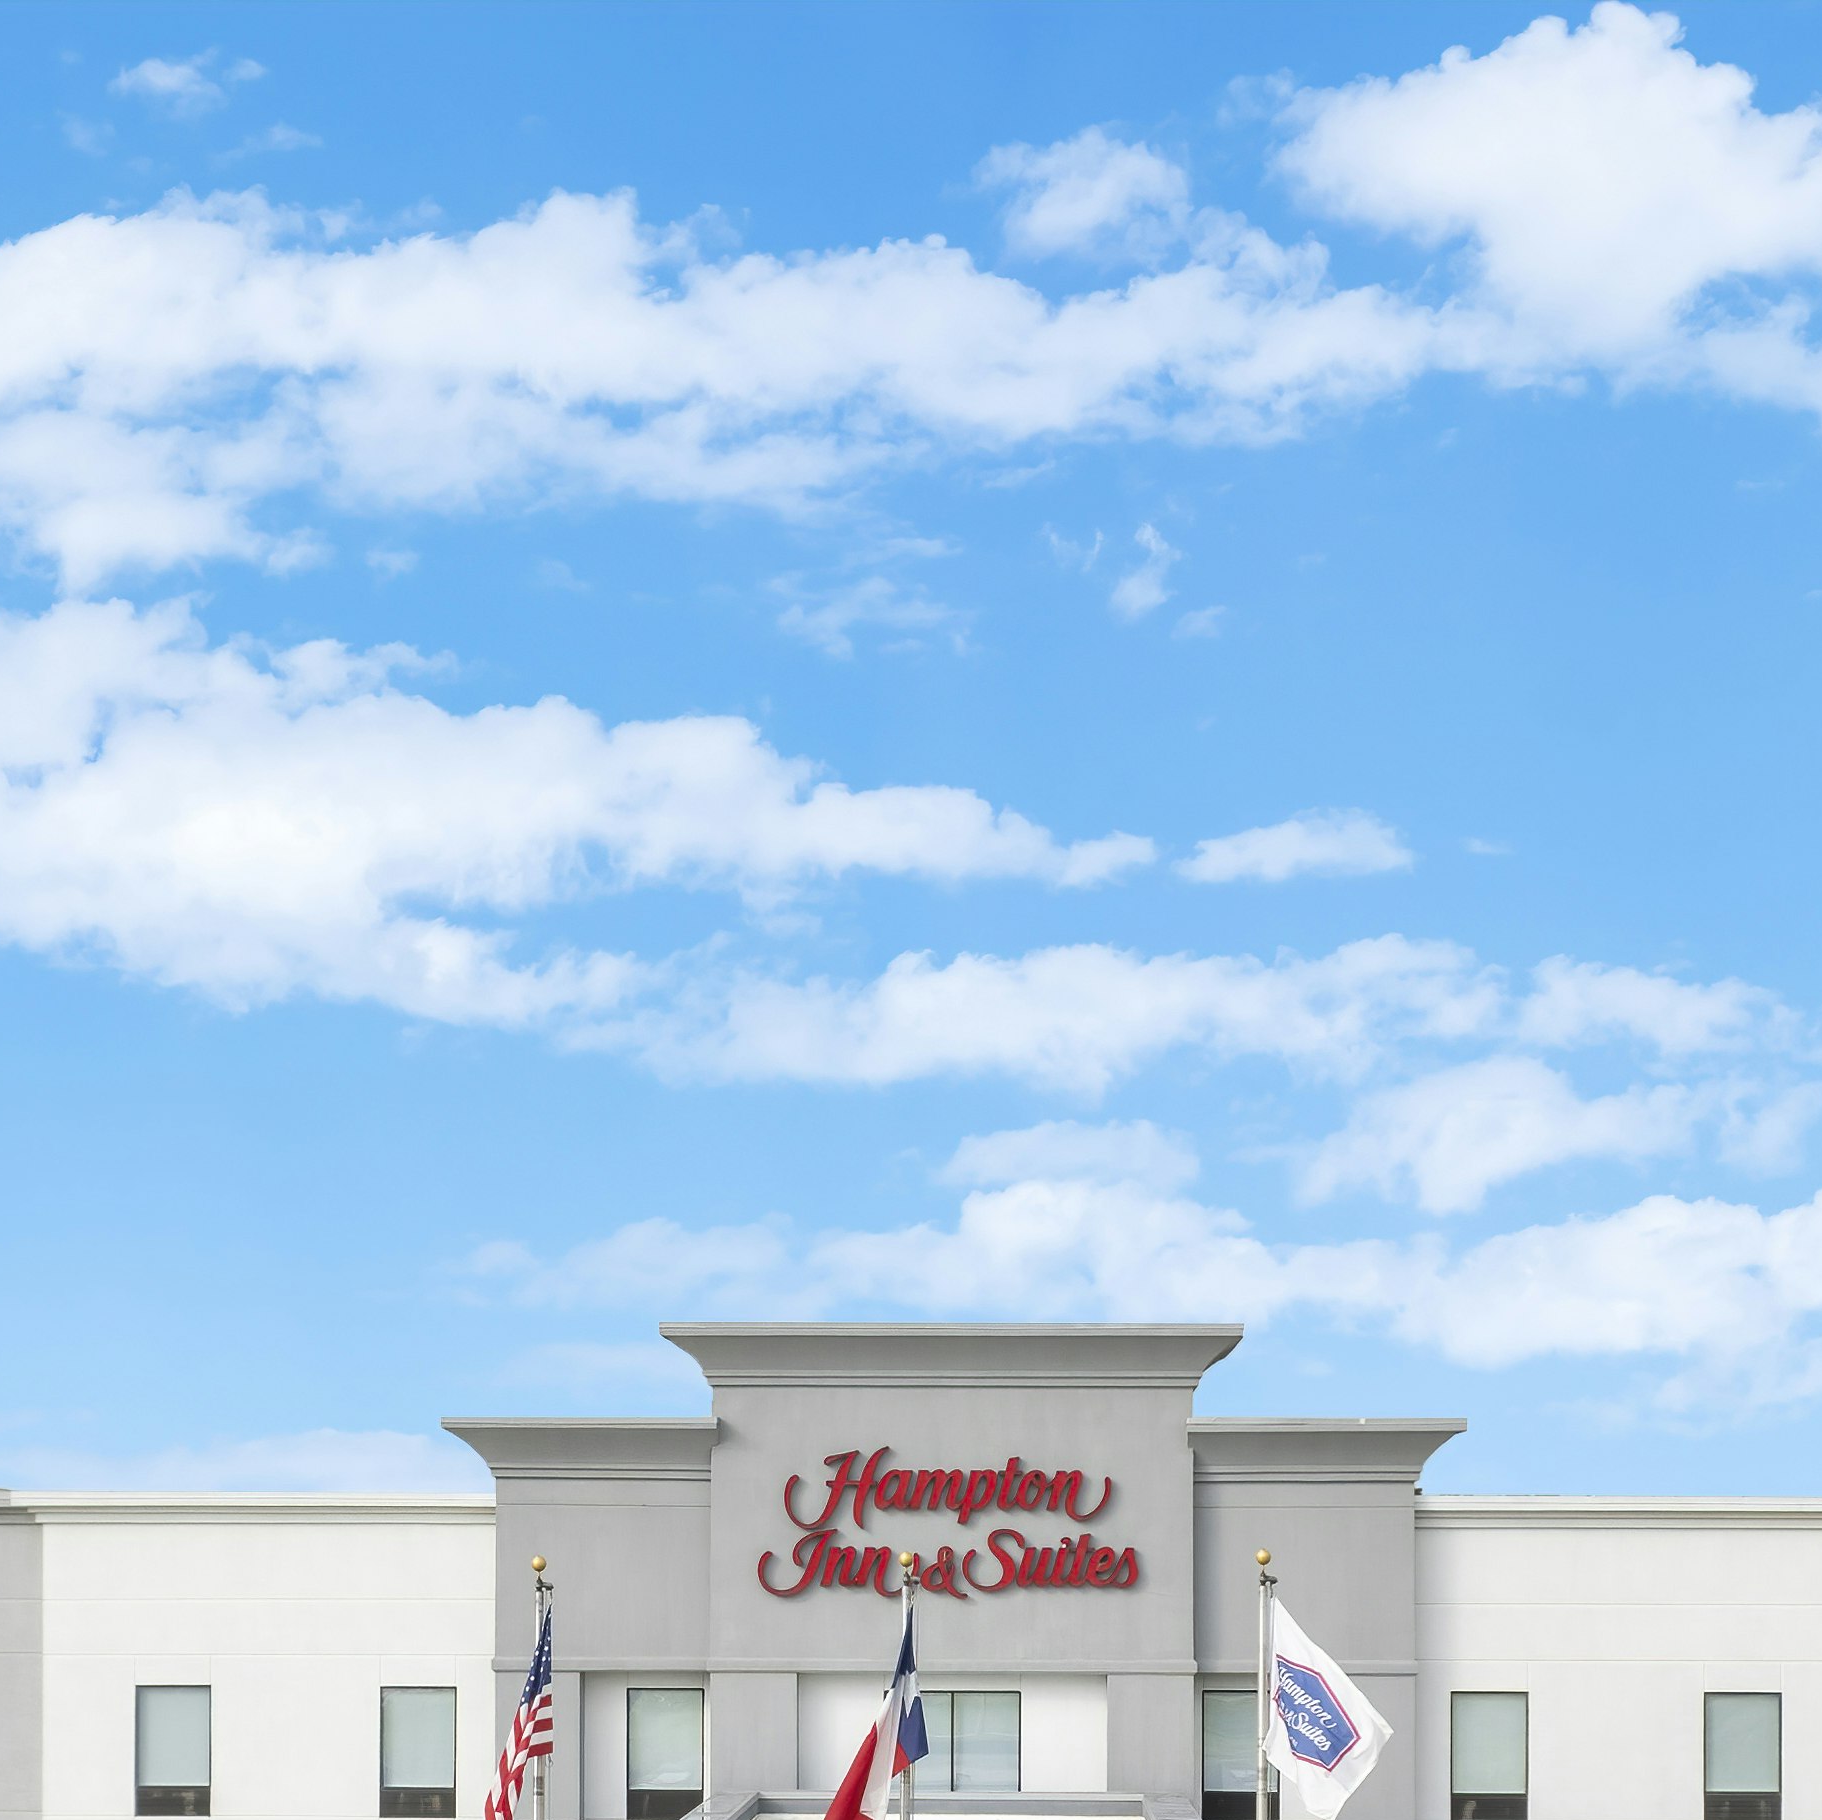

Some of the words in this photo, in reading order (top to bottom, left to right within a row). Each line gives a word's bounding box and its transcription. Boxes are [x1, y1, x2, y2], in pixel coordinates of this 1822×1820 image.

[783, 1446, 1112, 1530] Hampton
[757, 1528, 920, 1598] Inn
[920, 1546, 969, 1600] &
[962, 1528, 1139, 1592] Suites
[1278, 1666, 1337, 1729] Hampton
[1291, 1712, 1332, 1751] Suites
